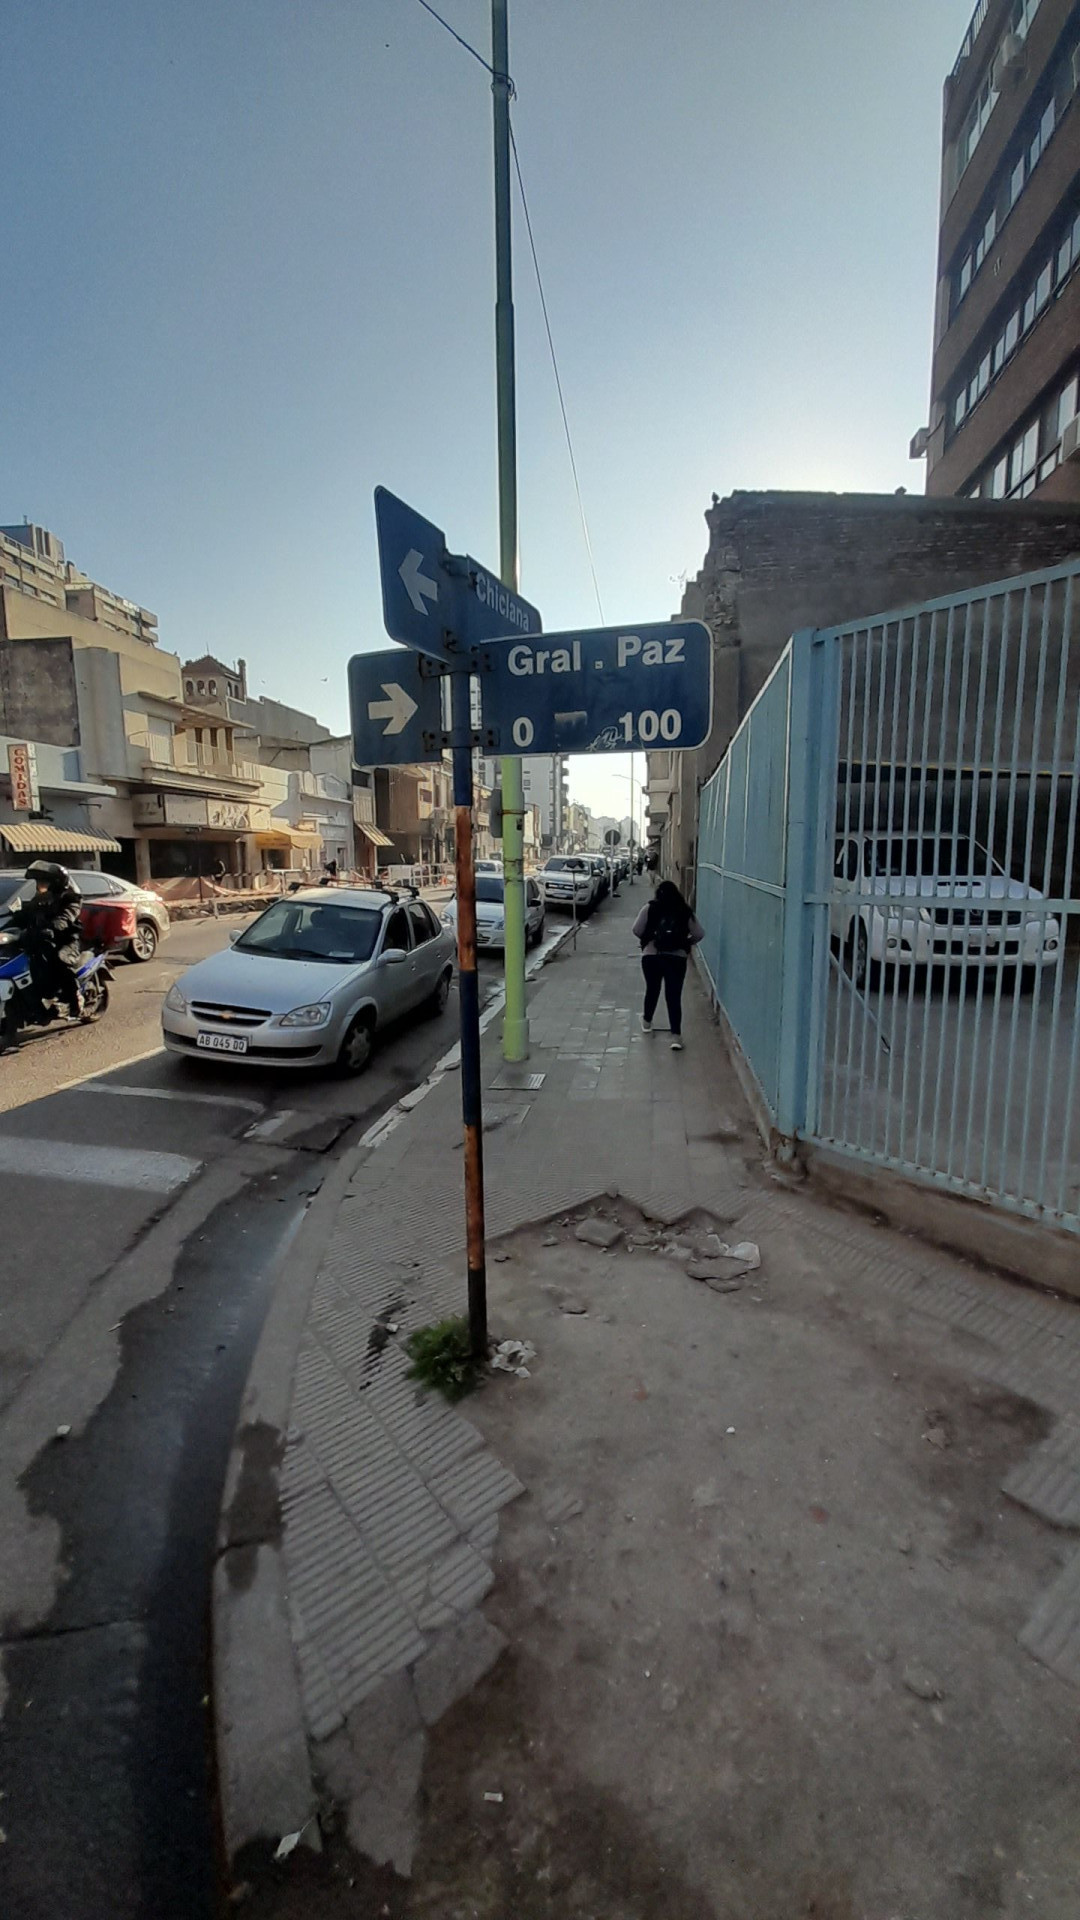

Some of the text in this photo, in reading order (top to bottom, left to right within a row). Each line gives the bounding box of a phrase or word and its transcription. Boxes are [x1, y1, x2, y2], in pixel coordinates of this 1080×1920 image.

[476, 571, 529, 633] Chiclana
[617, 635, 686, 668] Paz
[512, 716, 534, 748] 0
[618, 708, 682, 743] 100
[14, 748, 27, 806] COMIDAS
